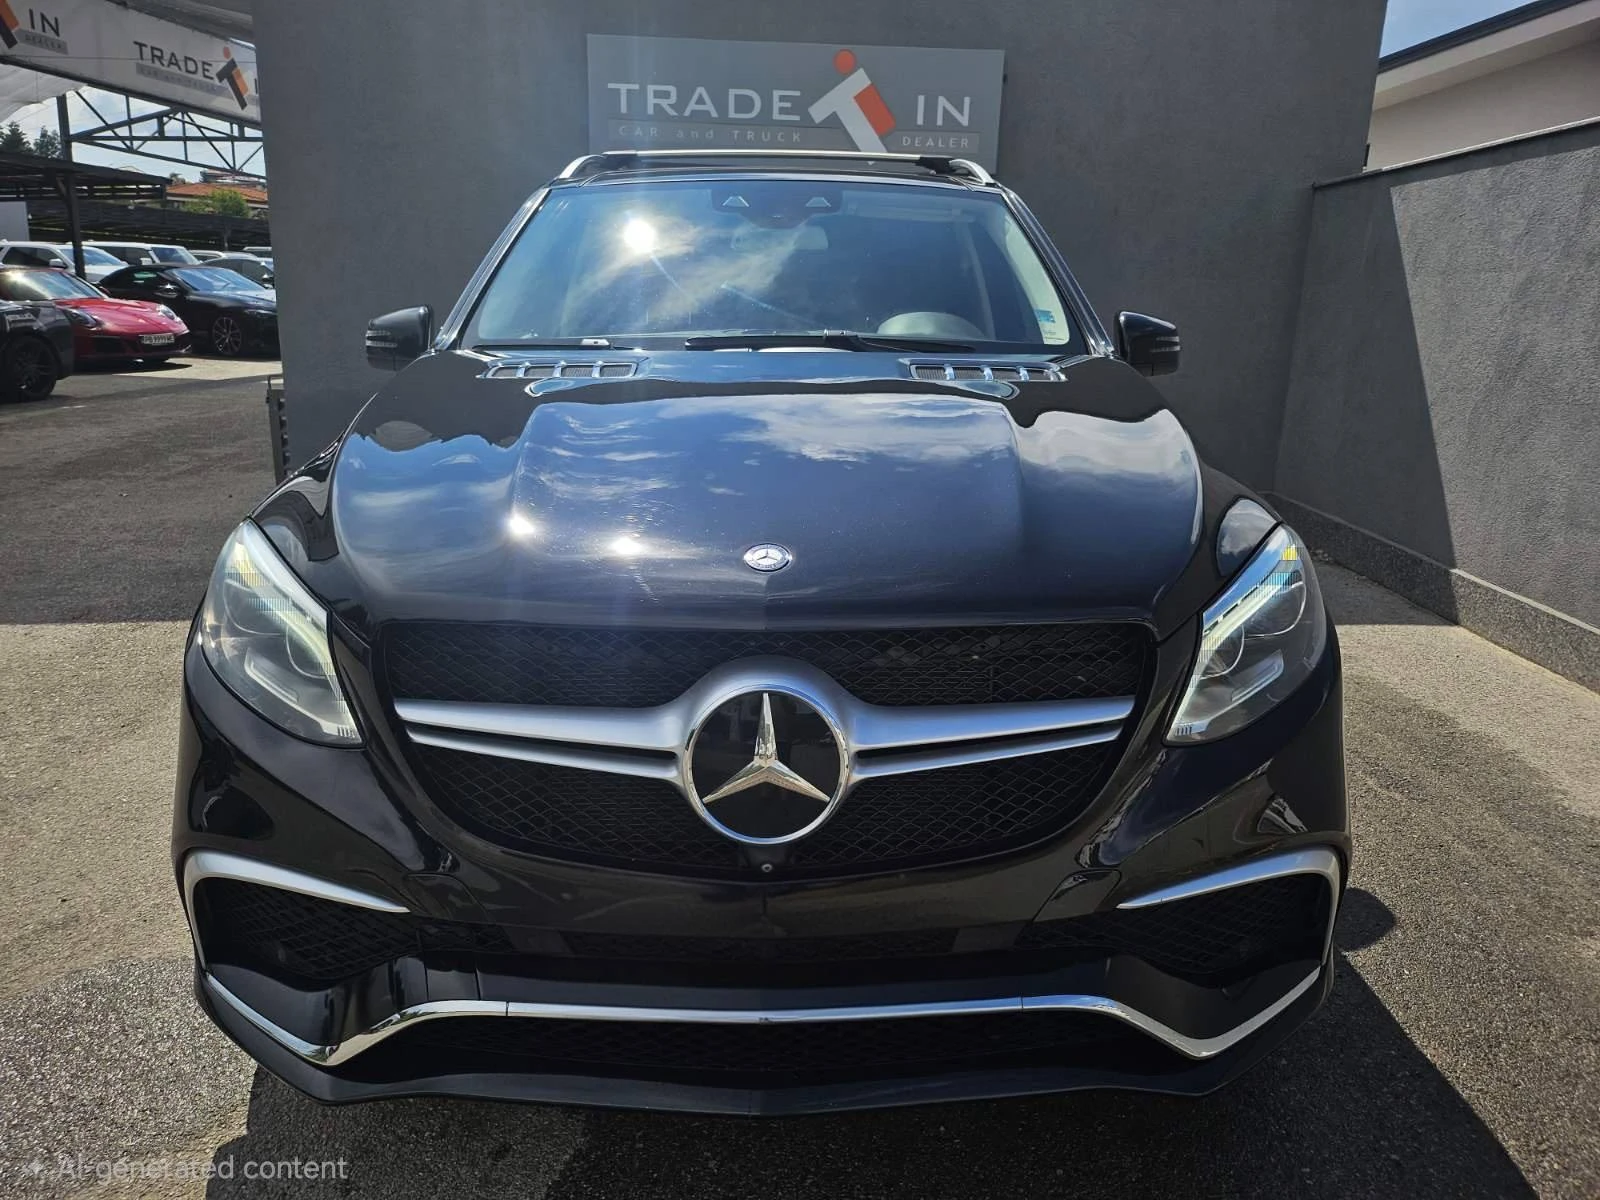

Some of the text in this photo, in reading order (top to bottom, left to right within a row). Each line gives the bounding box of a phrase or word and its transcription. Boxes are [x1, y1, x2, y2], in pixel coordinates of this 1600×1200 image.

[29, 8, 60, 37] IN
[133, 41, 214, 80] TRADE
[607, 83, 801, 121] TRADE
[916, 95, 971, 127] IN
[619, 126, 801, 143] CAR and TRUCK
[902, 136, 969, 149] DEALER
